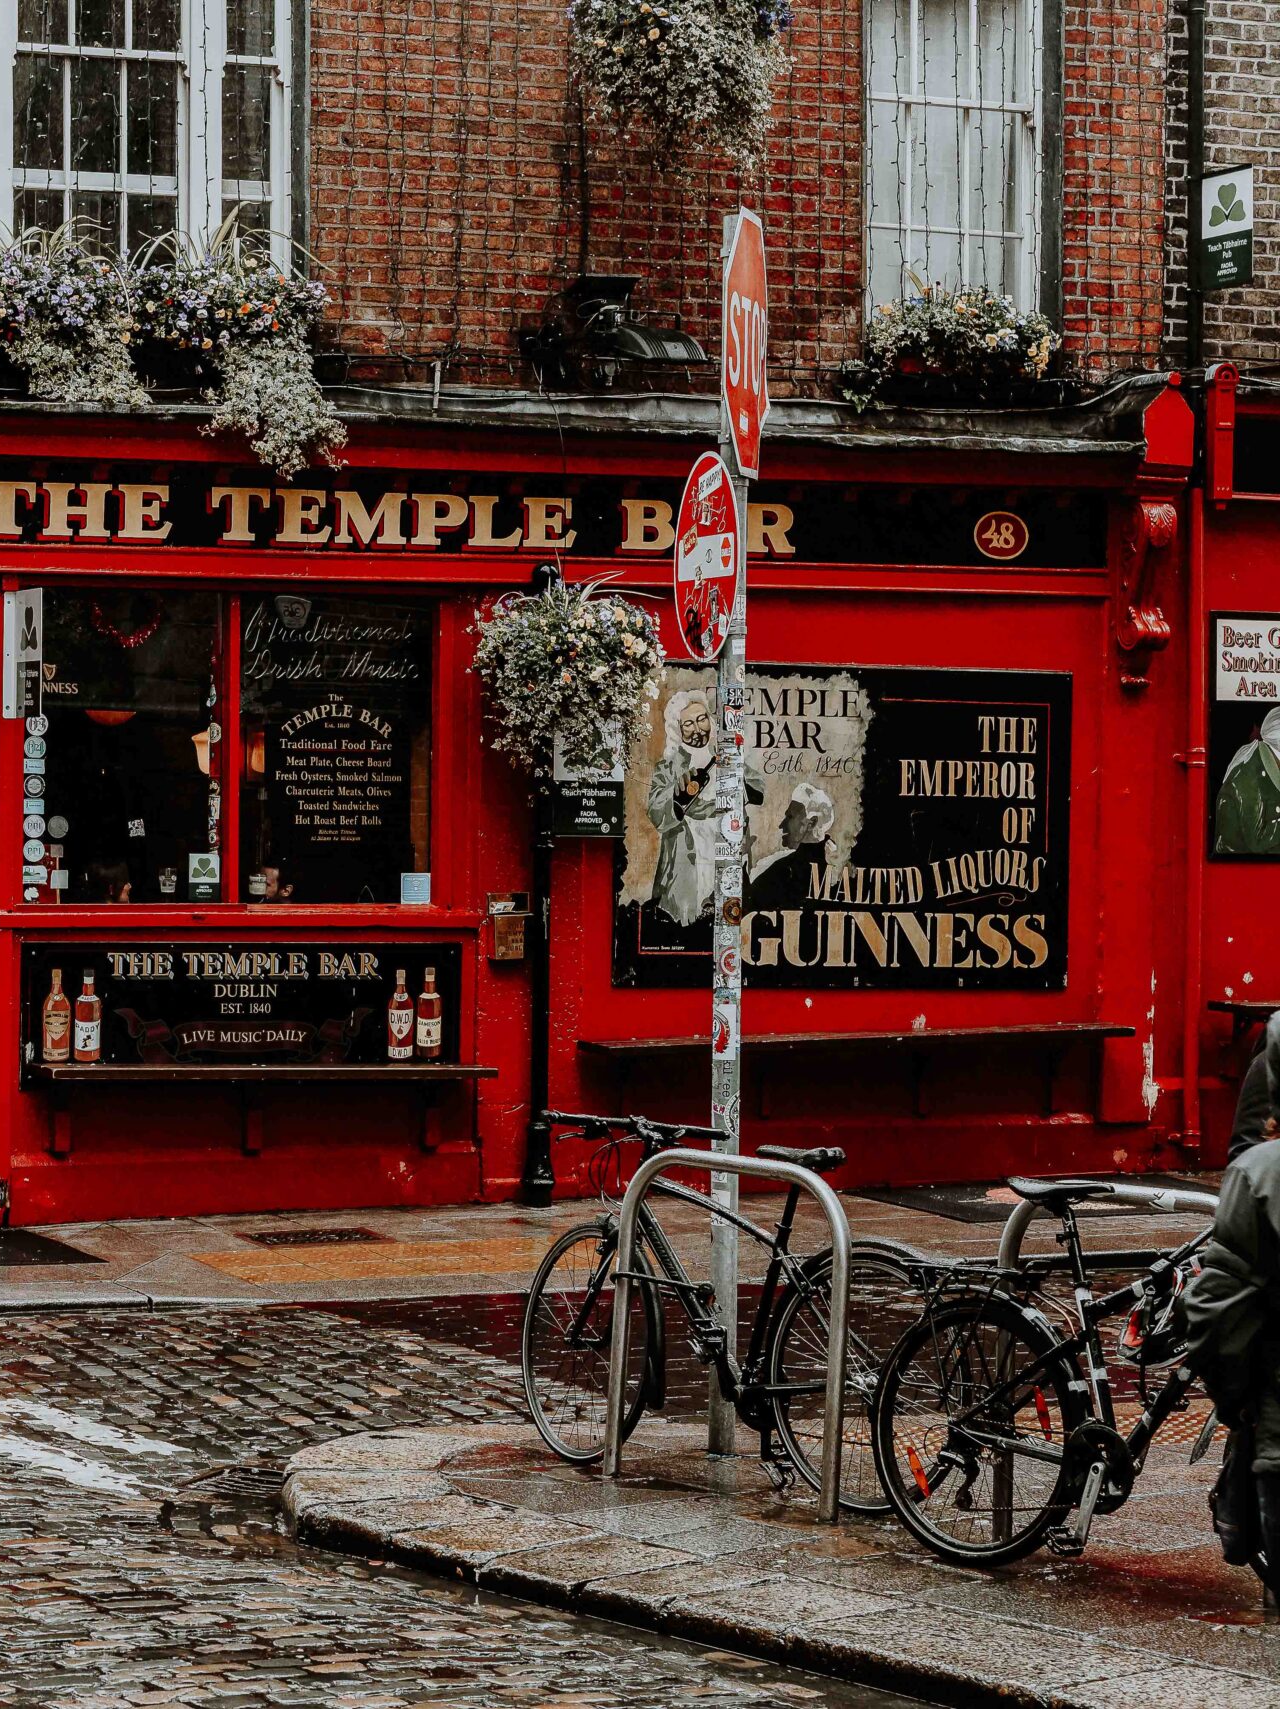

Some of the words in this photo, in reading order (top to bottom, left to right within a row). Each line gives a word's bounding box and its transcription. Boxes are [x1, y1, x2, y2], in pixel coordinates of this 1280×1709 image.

[1222, 250, 1233, 259] Pub
[728, 290, 766, 396] STOP
[208, 486, 578, 553] TEMPLE
[619, 498, 796, 555] BR
[983, 519, 1015, 550] 48
[1222, 625, 1263, 648] Beer
[42, 682, 79, 694] NNESS
[1235, 676, 1278, 697] Area
[328, 693, 344, 702] The
[281, 703, 353, 736] TEMPLE
[359, 708, 393, 739] BAR
[752, 720, 827, 754] BAR
[978, 716, 1037, 753] THE
[280, 738, 337, 749] Traditional
[341, 739, 366, 750] Food
[371, 740, 393, 751] Fare
[286, 756, 307, 767] Meat
[310, 756, 333, 768] Plate,
[336, 757, 364, 767] Cheese
[367, 757, 392, 768] Board
[275, 771, 298, 781] Fresh
[300, 771, 333, 784] Oysters,
[336, 772, 368, 782] Smoked
[371, 772, 402, 782] Salmon
[898, 759, 1037, 799] EMPEROR
[285, 785, 335, 796] Charcuterie
[338, 786, 364, 797] Meats,
[366, 786, 392, 797] Olives
[583, 787, 617, 797] Tábhairne
[298, 800, 330, 811] Toasted
[332, 801, 379, 811] Sandwiches
[582, 798, 596, 807] Pub
[295, 815, 311, 825] Hot
[314, 815, 336, 825] Roast
[339, 815, 359, 825] Beef
[361, 815, 382, 826] Rolls
[1002, 807, 1036, 844] OF
[806, 861, 924, 905] MALTED
[928, 848, 1048, 900] LIQUORS
[741, 910, 1049, 969] GUINNESS
[107, 952, 175, 980] THE
[182, 952, 310, 980] TEMPLE
[317, 952, 383, 980] BAR
[213, 984, 278, 998] DUBLIN
[220, 1003, 245, 1014] EST.
[249, 1003, 271, 1014] 1840
[184, 1030, 216, 1044] LIVE
[220, 1031, 262, 1043] MUSIC
[266, 1030, 307, 1043] DAILY
